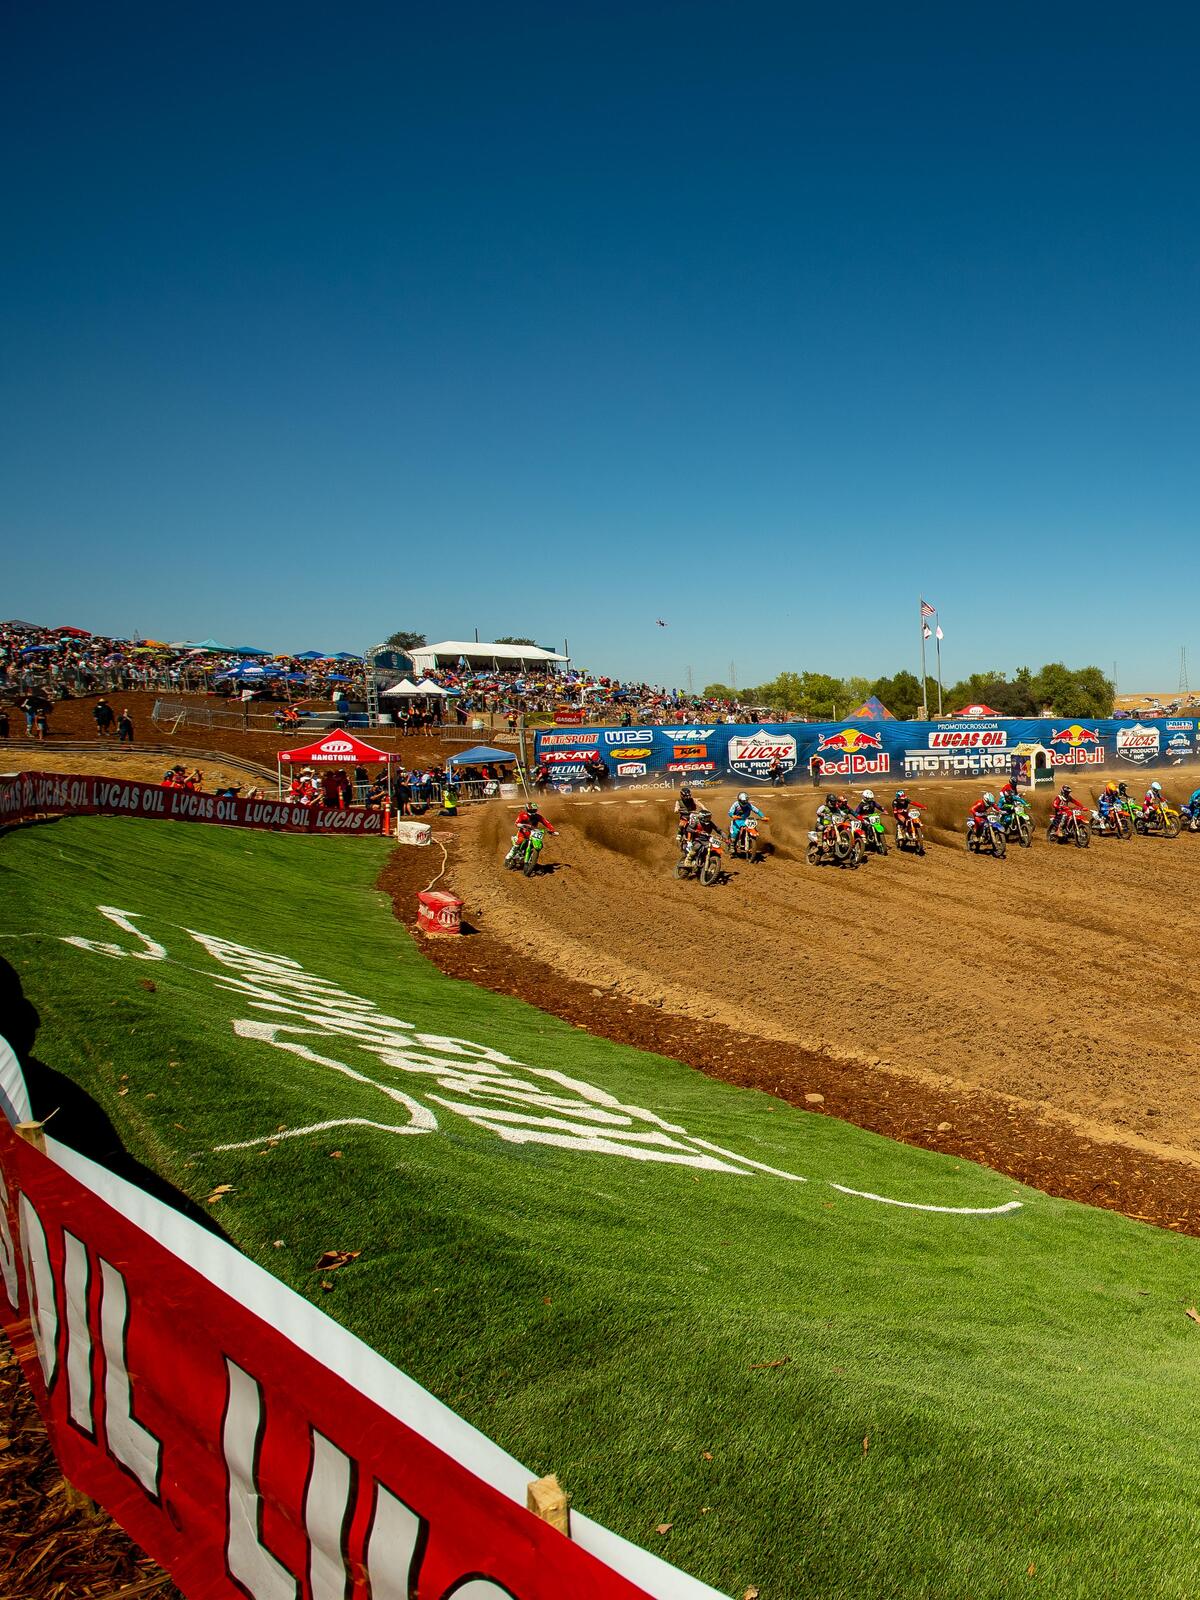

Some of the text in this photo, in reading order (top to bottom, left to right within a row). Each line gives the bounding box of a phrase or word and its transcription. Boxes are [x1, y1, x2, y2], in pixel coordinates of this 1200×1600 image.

[605, 730, 653, 744] WPS
[661, 729, 716, 740] FLY
[932, 732, 1004, 747] LUCAS OIL
[1122, 736, 1156, 747] LUCAS
[737, 745, 793, 760] LUCAS
[1076, 746, 1104, 764] Bull
[621, 766, 643, 775] 100%
[669, 763, 713, 771] GASGAS
[852, 752, 890, 774] Bull
[904, 754, 1011, 771] MOTOCROS
[904, 768, 1011, 778] CHAMPIONSH
[71, 781, 88, 807] OIL
[93, 782, 165, 812] LUCAS OIL
[171, 793, 238, 821] LUCAS OIL
[245, 803, 310, 827] LUCAS OIL
[316, 810, 381, 830] LUCAS OIL
